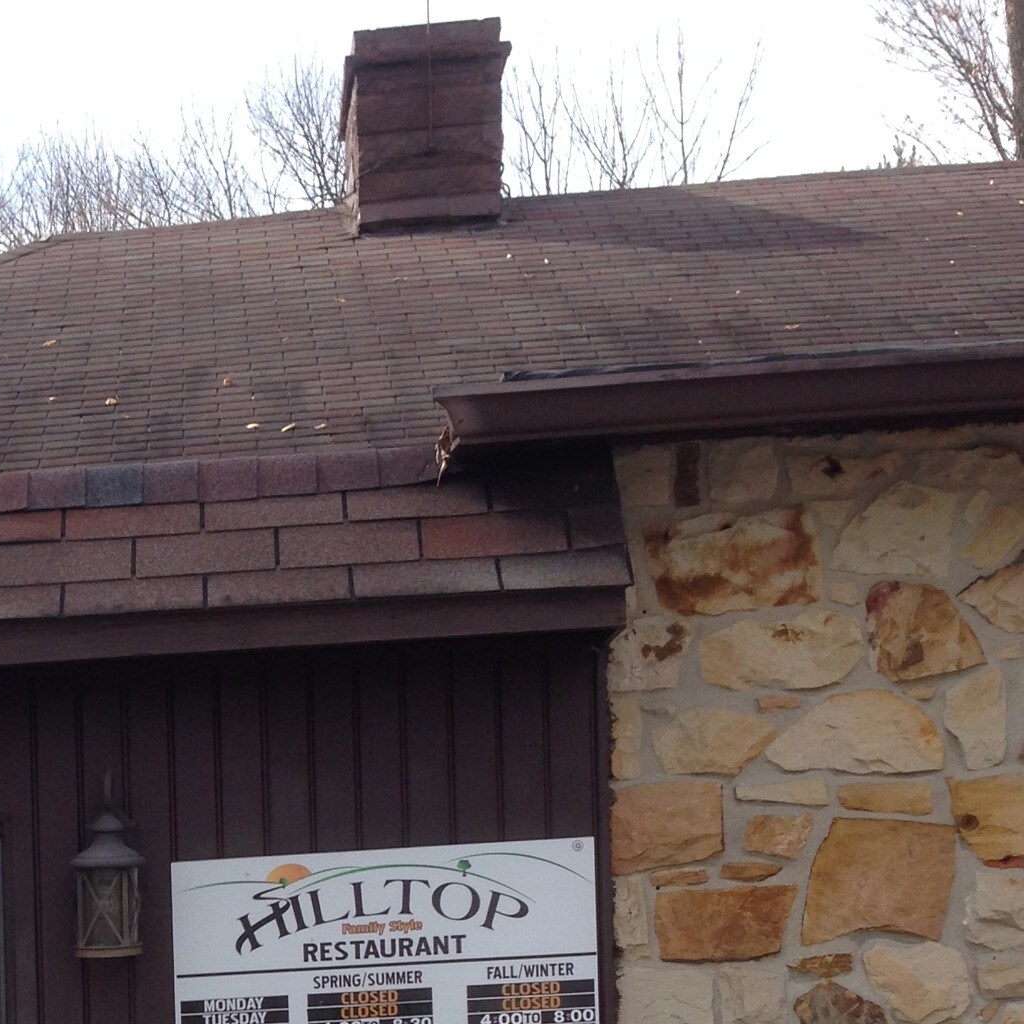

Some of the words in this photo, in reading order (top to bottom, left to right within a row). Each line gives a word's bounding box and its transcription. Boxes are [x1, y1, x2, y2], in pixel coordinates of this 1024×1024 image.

[235, 879, 529, 955] HILLTOP
[342, 921, 385, 936] Family
[389, 919, 423, 934] Style
[303, 934, 467, 962] RESTAURANT
[313, 970, 423, 989] SPRING/SUMMER
[487, 962, 574, 980] FALL/WINTER
[204, 997, 264, 1013] MONDAY
[341, 989, 398, 1005] CLOSED
[501, 981, 560, 996] CLOSED
[341, 1003, 398, 1019] CLOSED
[502, 995, 561, 1011] CLOSED
[524, 1012, 540, 1024] TO
[554, 1008, 594, 1023] 8:00
